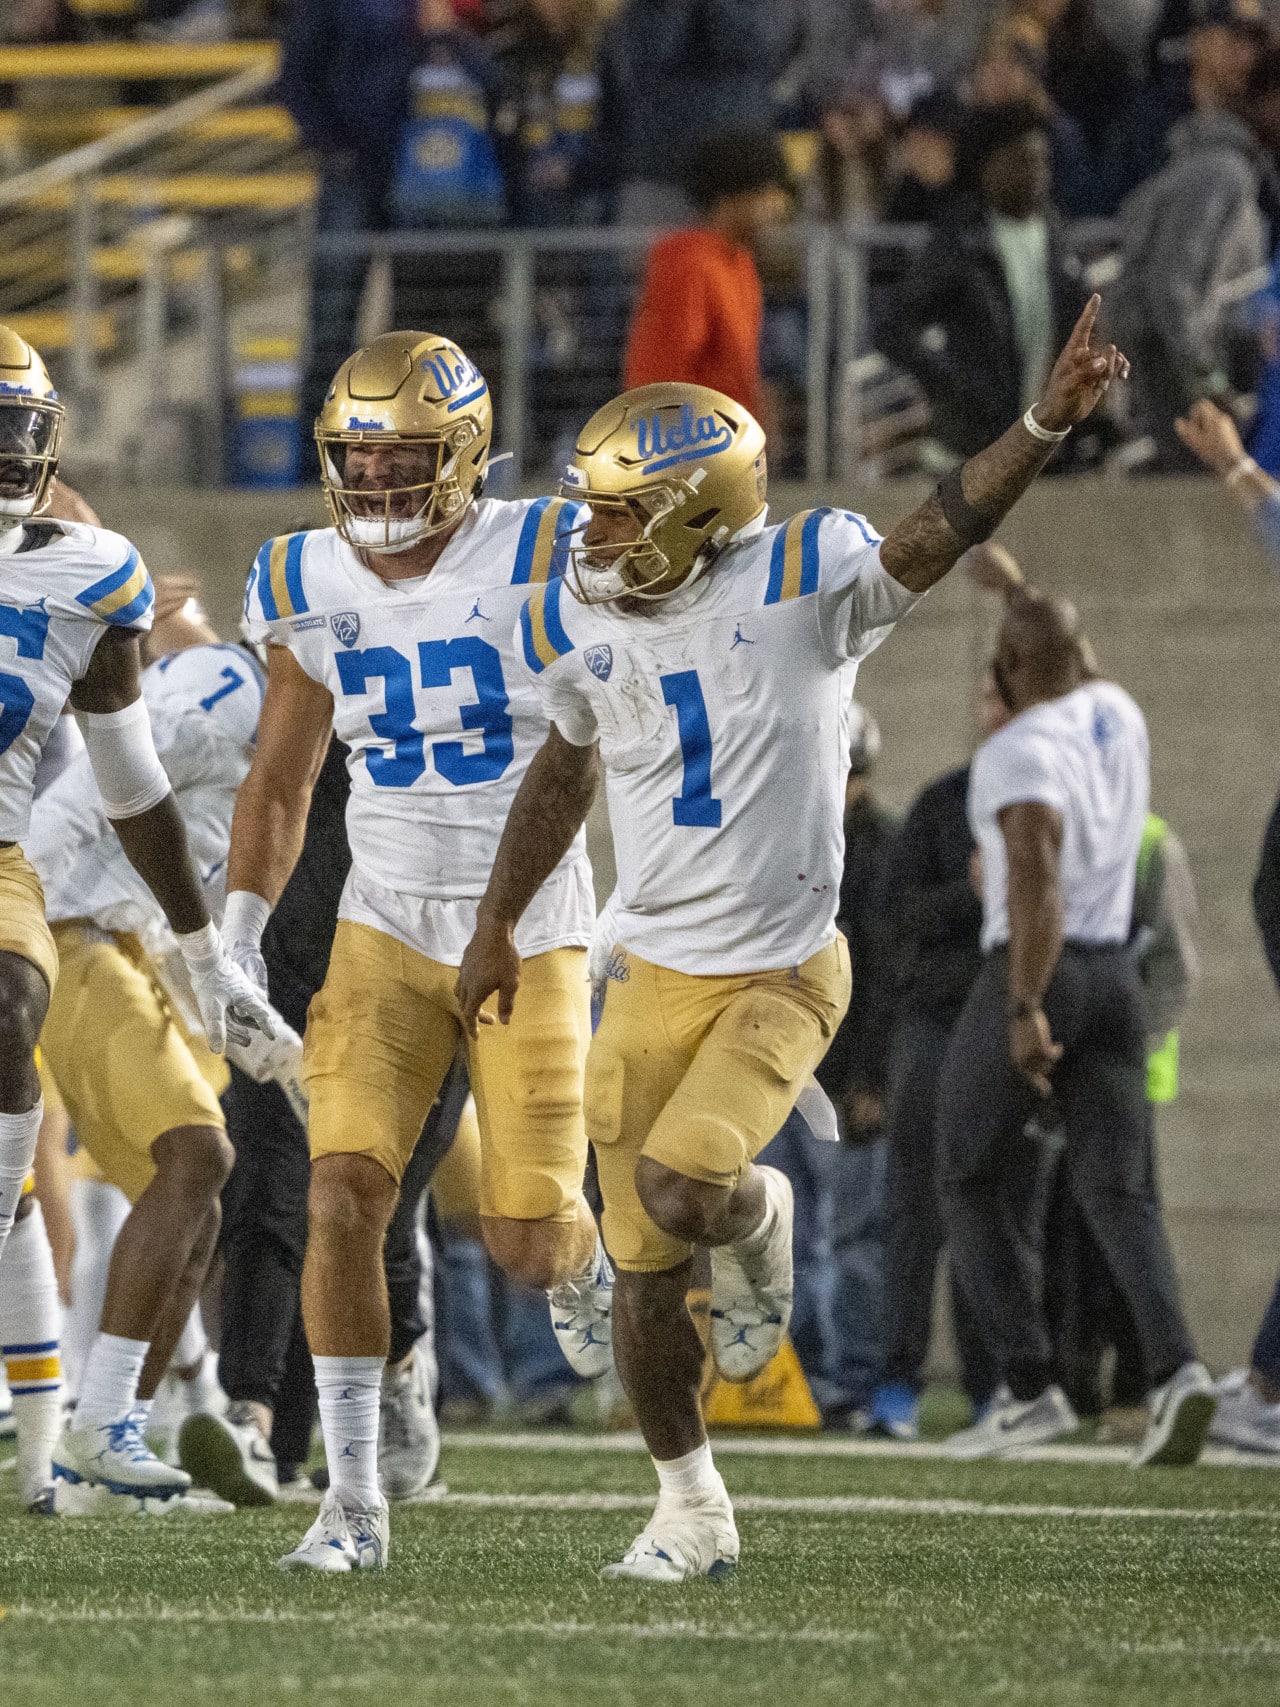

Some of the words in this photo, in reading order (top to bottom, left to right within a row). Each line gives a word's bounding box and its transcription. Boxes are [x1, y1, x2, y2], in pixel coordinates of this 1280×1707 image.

[630, 402, 733, 476] Ucla
[331, 612, 360, 635] PAC
[340, 626, 355, 642] 12
[584, 646, 611, 670] PAC
[334, 636, 514, 787] 33
[659, 669, 723, 828] 1
